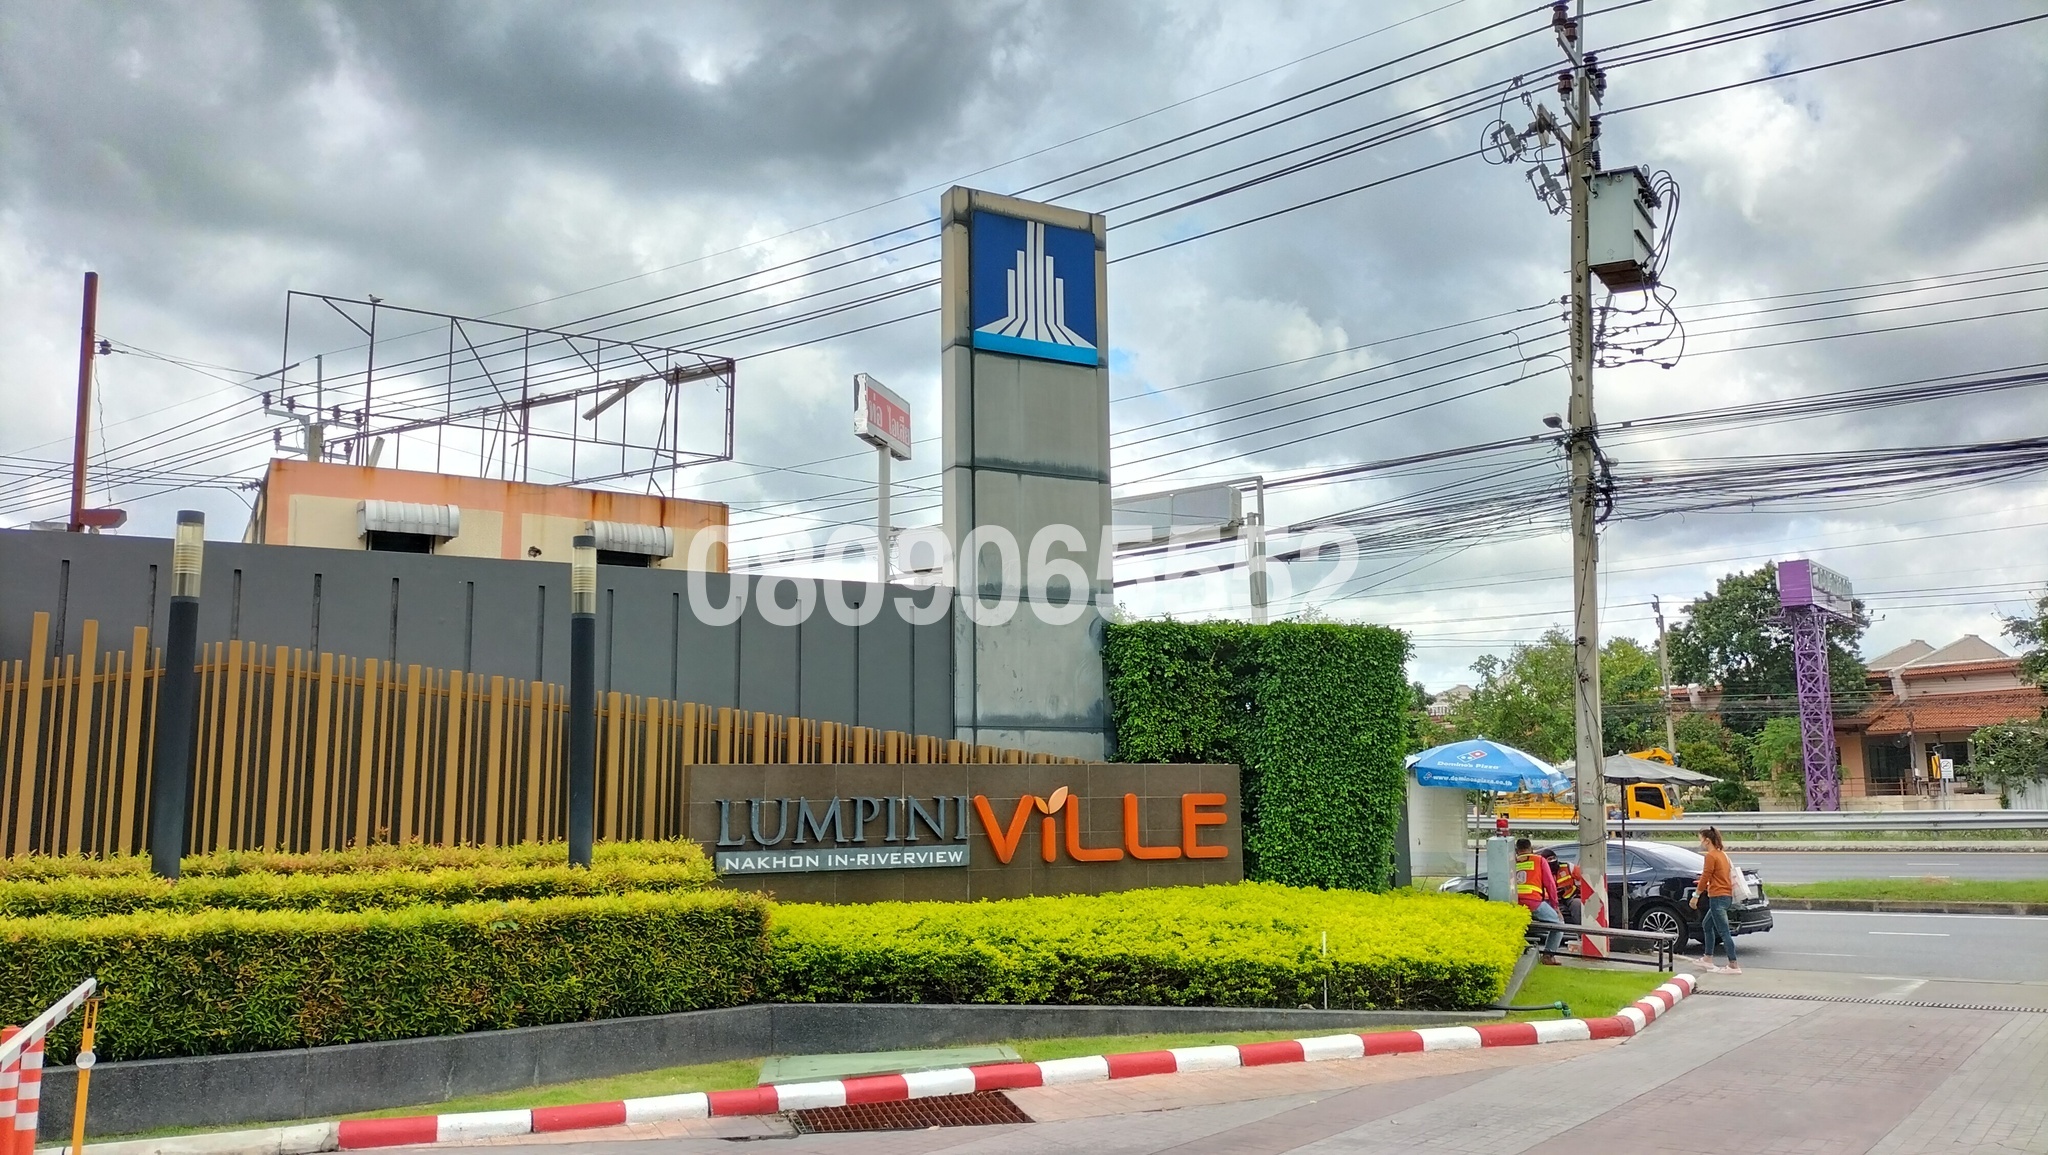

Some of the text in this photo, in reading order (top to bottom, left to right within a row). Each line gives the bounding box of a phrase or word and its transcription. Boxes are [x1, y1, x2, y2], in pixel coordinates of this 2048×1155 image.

[1437, 760, 1473, 769] Domino's
[716, 795, 968, 847] LUMPINI
[725, 851, 964, 870] NAKHON IN-RIVERVIEW
